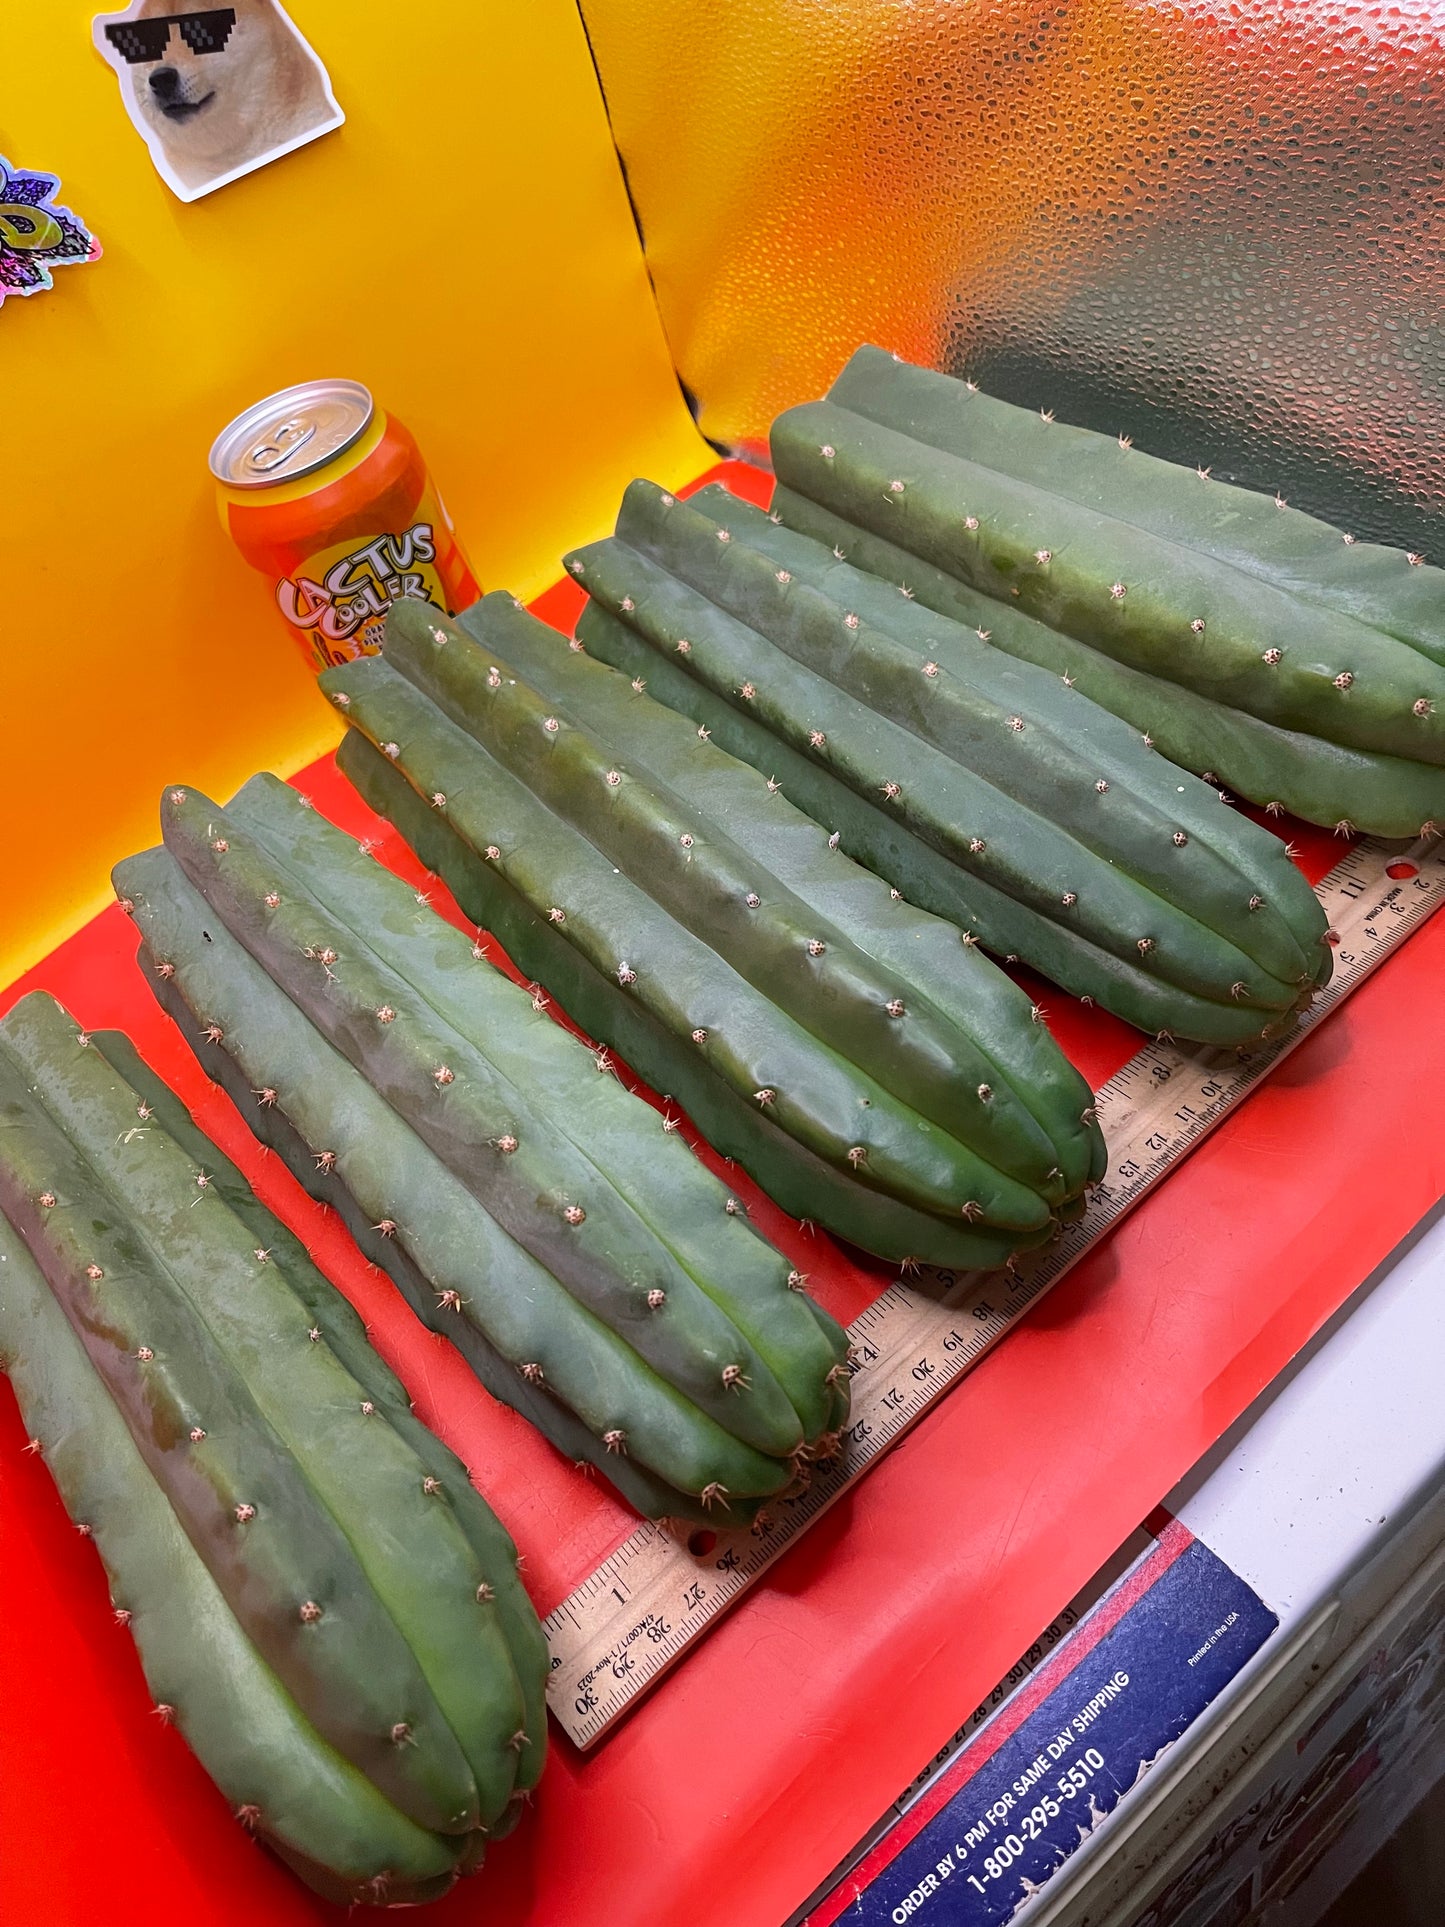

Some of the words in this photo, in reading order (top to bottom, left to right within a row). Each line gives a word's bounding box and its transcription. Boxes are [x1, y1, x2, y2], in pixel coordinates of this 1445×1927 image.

[275, 523, 436, 629] CACTUS
[319, 573, 431, 640] COOLER
[1413, 878, 1430, 889] 2
[1389, 902, 1406, 913] 3
[1364, 927, 1378, 937] 4
[1339, 951, 1355, 962] 5
[1201, 1079, 1223, 1098] 10
[1174, 1104, 1196, 1122] 11
[1145, 1131, 1169, 1151] 12
[1119, 1158, 1141, 1178] 13
[1090, 1184, 1113, 1206] 14
[609, 1588, 628, 1607] 1
[863, 1346, 879, 1362] 4
[1152, 1066, 1171, 1080] 8
[1339, 881, 1366, 900] 11
[1004, 1273, 1025, 1292] 17
[973, 1302, 995, 1321] 18
[943, 1331, 964, 1352] 19
[912, 1357, 936, 1381] 20
[880, 1388, 905, 1412] 21
[848, 1419, 873, 1444] 22
[716, 1548, 741, 1571] 26
[683, 1581, 707, 1612] 27
[647, 1615, 672, 1644] 28
[1026, 1643, 1043, 1664] 29
[1043, 1625, 1061, 1644] 30
[1062, 1607, 1078, 1624] 31
[1187, 1641, 1212, 1667] Printed
[1208, 1635, 1218, 1645] in
[1215, 1624, 1228, 1637] the
[1224, 1611, 1240, 1626] USA
[612, 1651, 636, 1680] 29
[1006, 1662, 1023, 1684] 30
[575, 1687, 600, 1716] 30
[892, 1873, 941, 1924] ORDER
[936, 1853, 956, 1879] BY
[955, 1843, 968, 1860] 6
[964, 1820, 990, 1849] PM
[985, 1792, 1017, 1826] FOR
[1013, 1755, 1052, 1797] SAME
[1046, 1727, 1075, 1760] DAY
[1072, 1671, 1129, 1733] SHIPPING
[966, 1748, 1104, 1894] 1-800-295-5510
